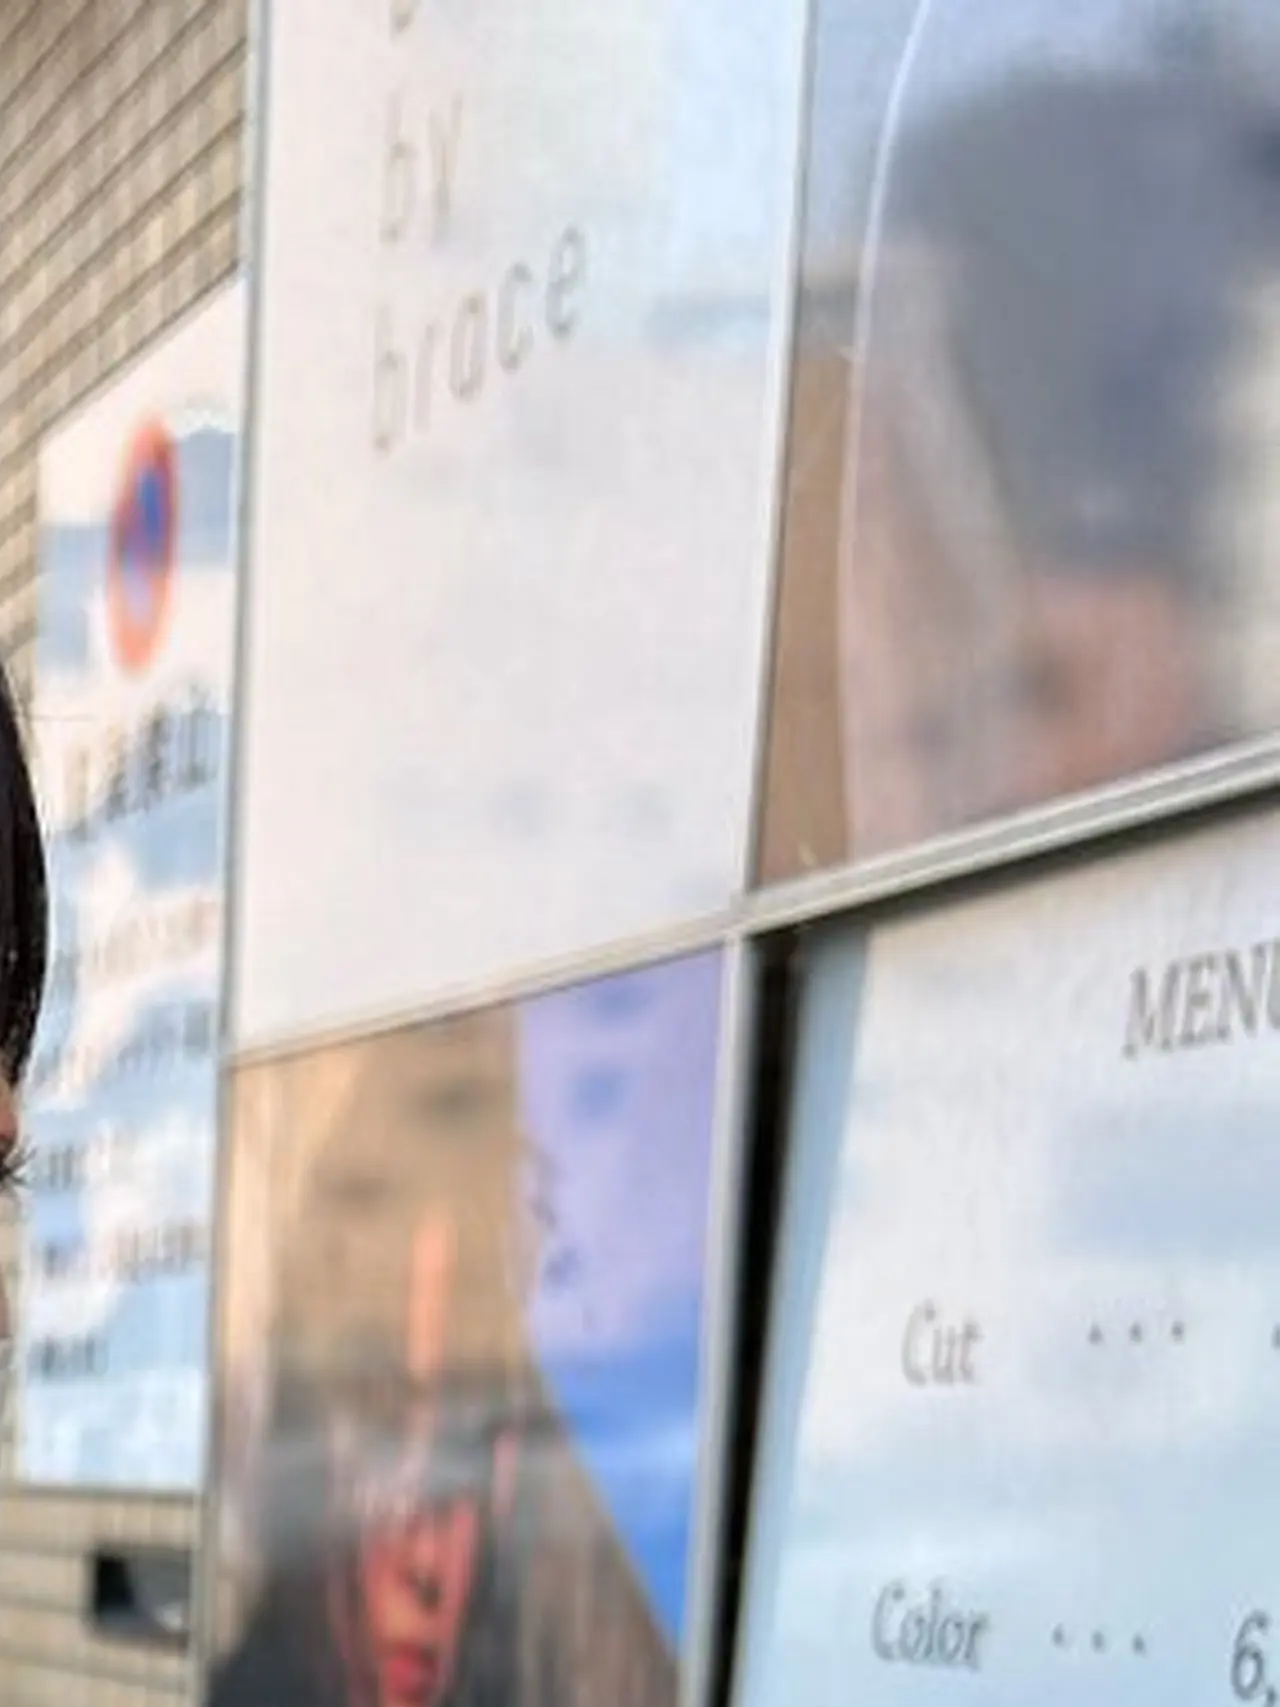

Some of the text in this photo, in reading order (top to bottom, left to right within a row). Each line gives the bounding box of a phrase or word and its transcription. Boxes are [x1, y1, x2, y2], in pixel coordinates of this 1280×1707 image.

[380, 92, 462, 248] by
[901, 1300, 981, 1387] Cut
[871, 1580, 988, 1671] Color
